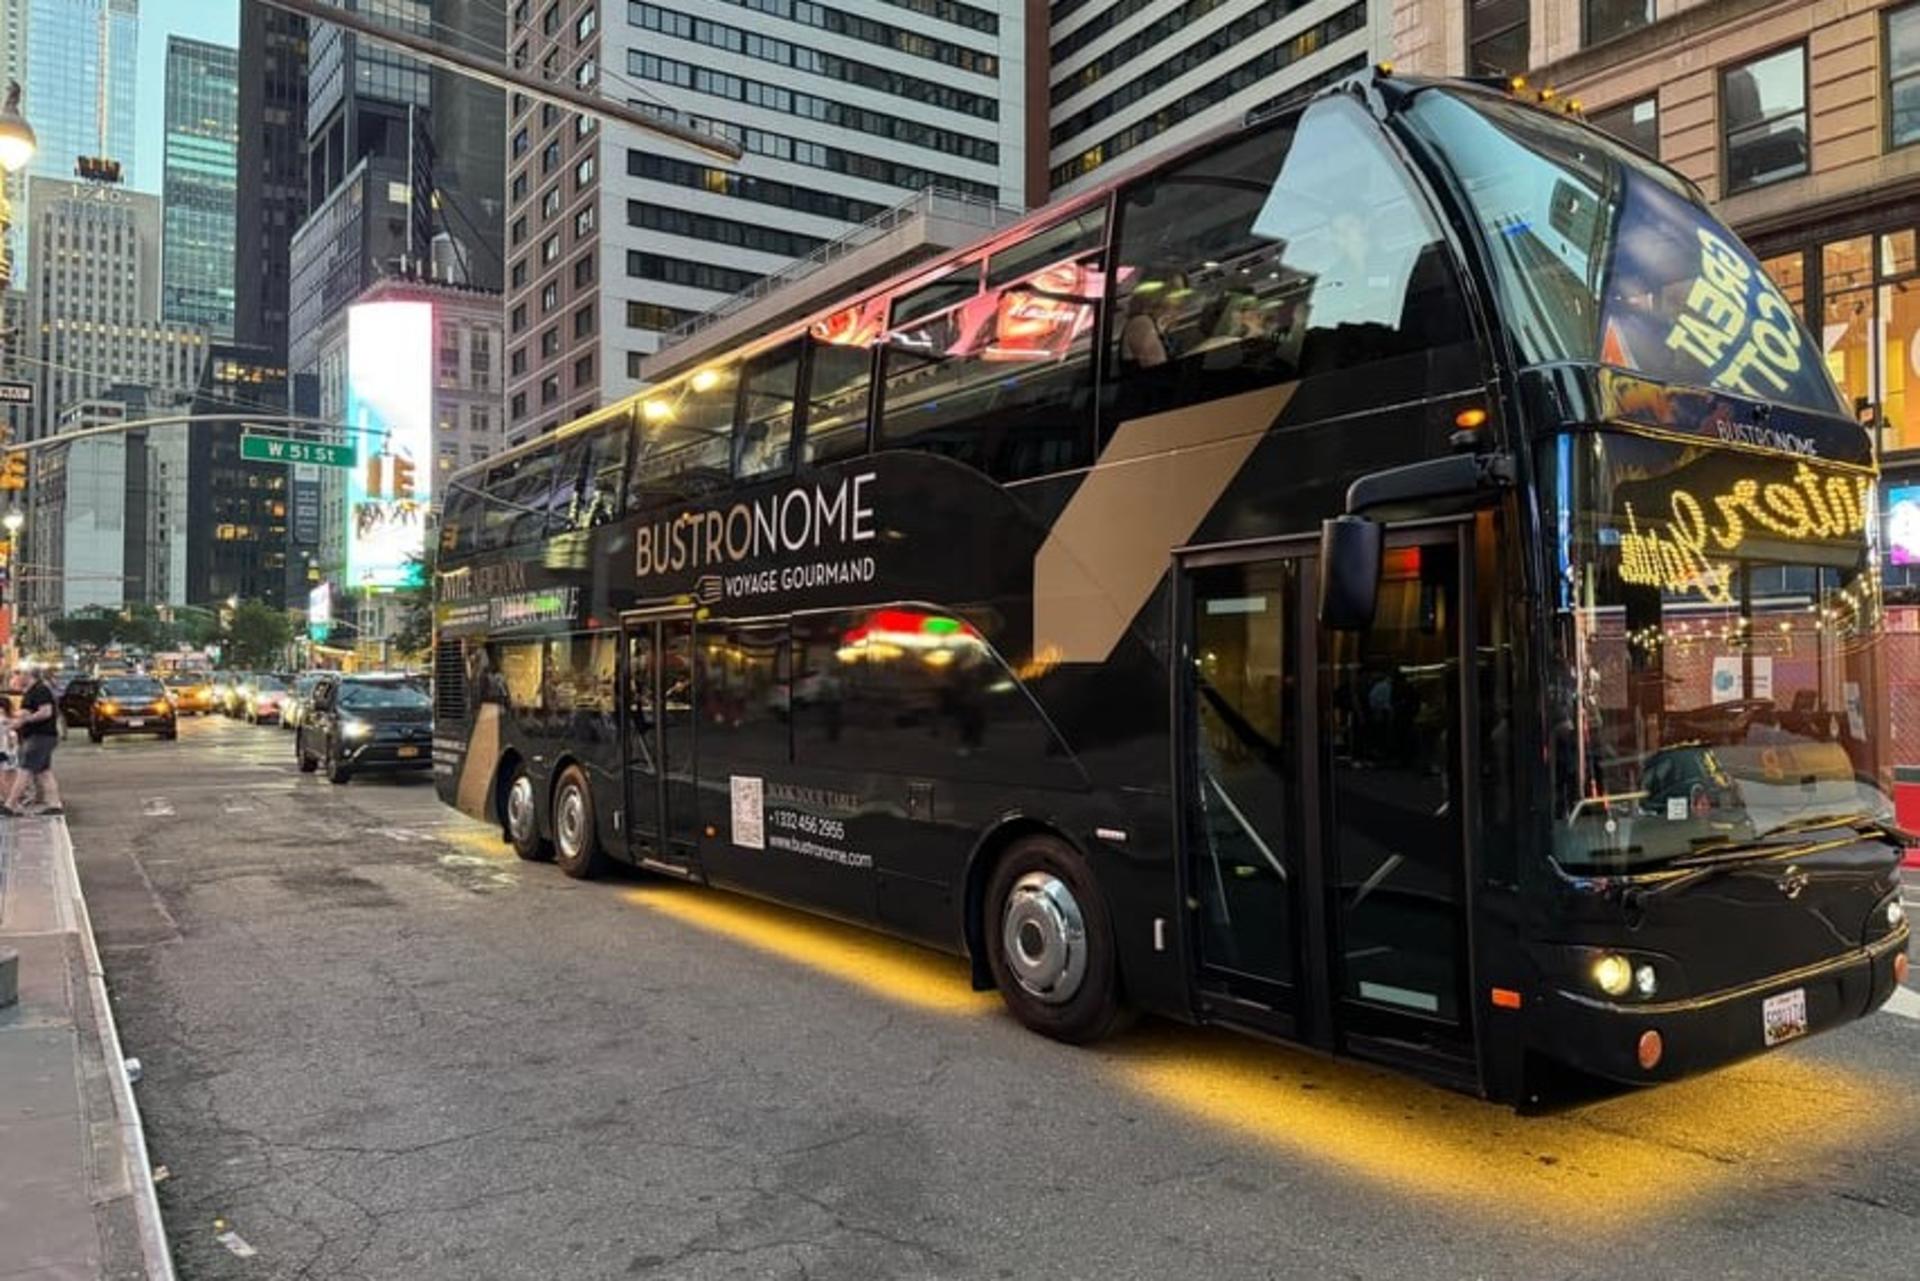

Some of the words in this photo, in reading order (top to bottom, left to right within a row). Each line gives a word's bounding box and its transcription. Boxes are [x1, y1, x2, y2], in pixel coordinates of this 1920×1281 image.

[267, 441, 284, 457] W
[289, 444, 309, 460] 51
[315, 447, 335, 462] St
[1716, 420, 1818, 456] BUSTRONOME
[635, 472, 877, 577] BUSTRONOME
[724, 569, 778, 598] VOYAGE
[780, 557, 876, 590] GOURMAND
